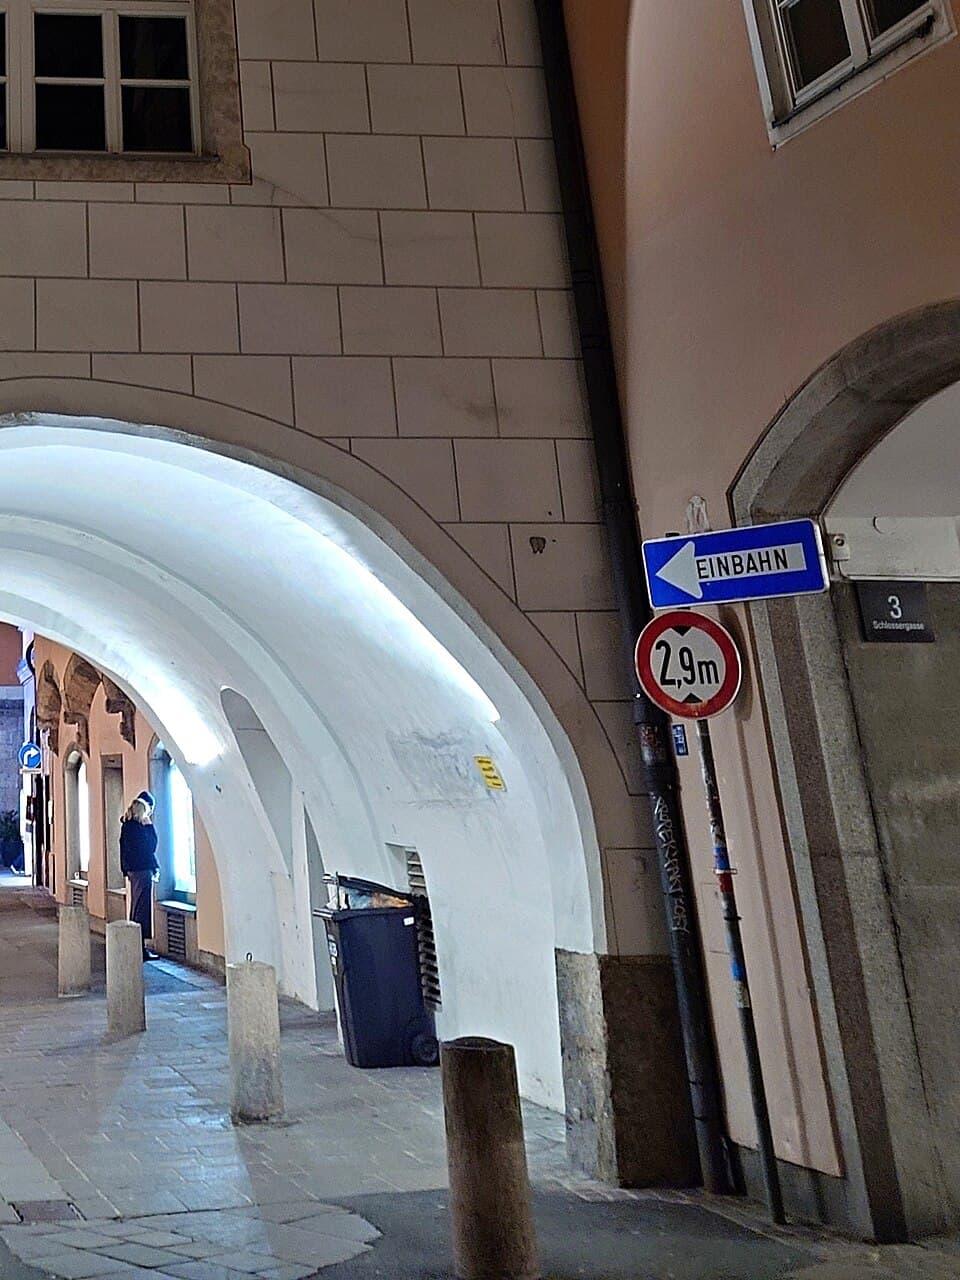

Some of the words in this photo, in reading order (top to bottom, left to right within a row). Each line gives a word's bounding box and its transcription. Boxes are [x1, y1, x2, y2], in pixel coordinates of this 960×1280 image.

[696, 548, 789, 580] EINBAHN
[887, 595, 902, 619] 3
[655, 639, 720, 689] 2,9m
